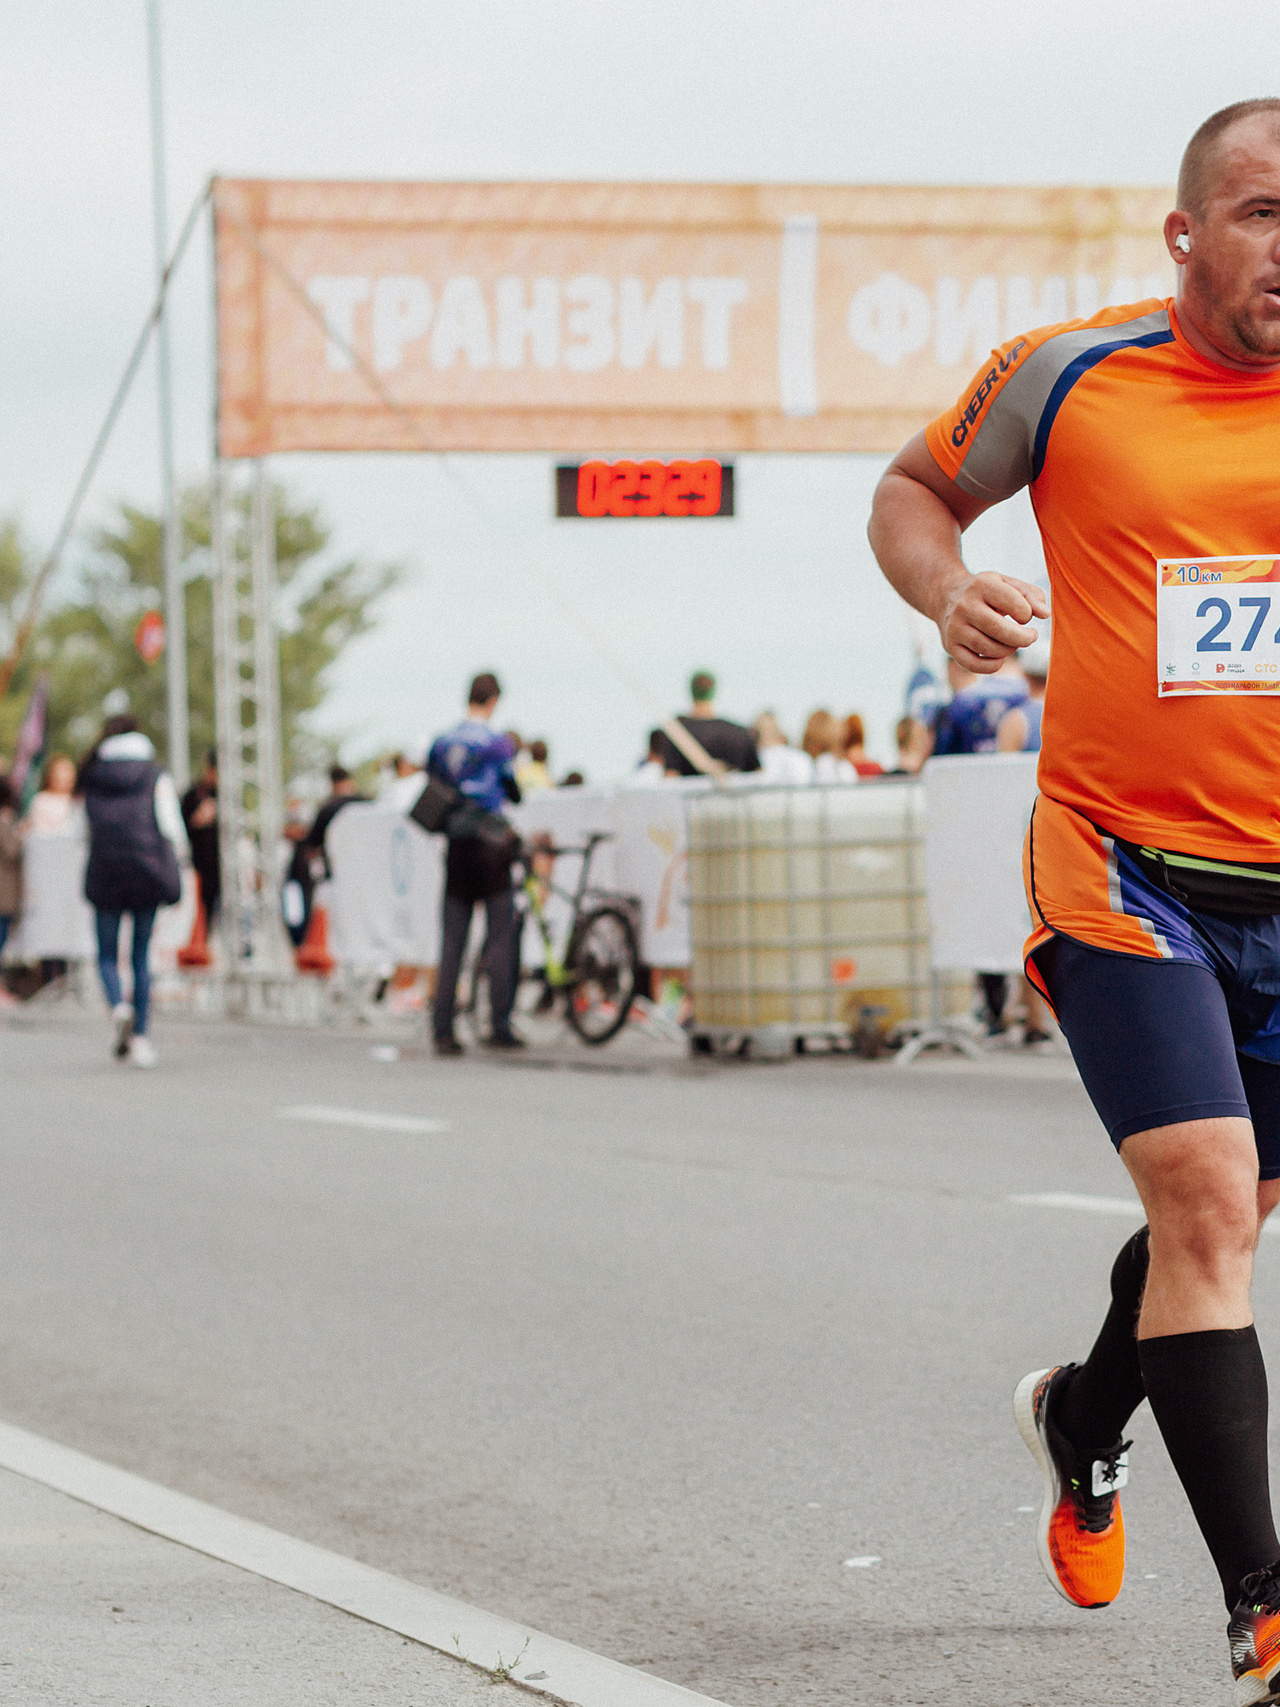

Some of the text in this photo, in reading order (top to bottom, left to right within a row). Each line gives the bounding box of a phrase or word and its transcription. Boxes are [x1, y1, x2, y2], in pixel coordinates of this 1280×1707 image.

[308, 270, 1167, 371] ТРАНЗИТ ФИН
[952, 341, 1026, 447] CHEER UP
[1177, 565, 1200, 583] 10
